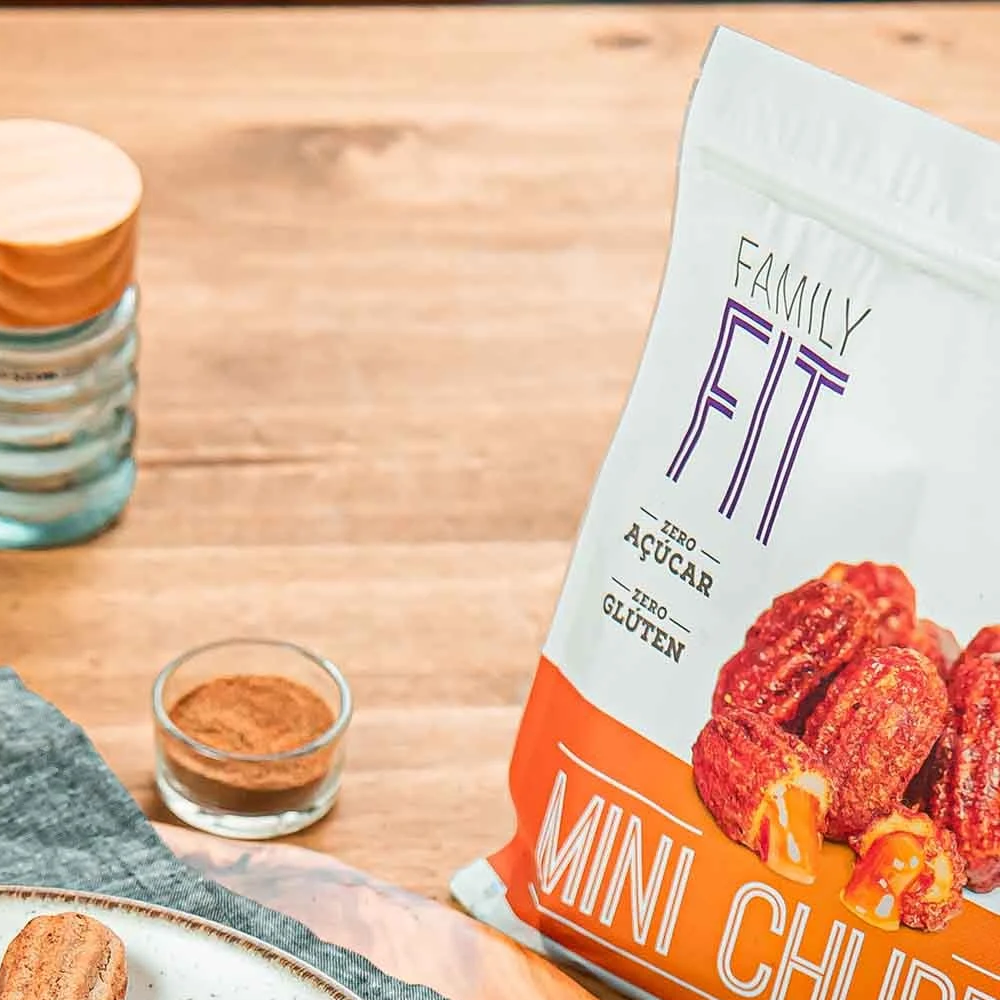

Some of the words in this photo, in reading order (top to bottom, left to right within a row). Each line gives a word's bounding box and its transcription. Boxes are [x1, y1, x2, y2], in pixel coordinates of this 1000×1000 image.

[734, 235, 871, 356] FAMILY
[665, 298, 849, 546] FIT
[624, 523, 713, 597] AÇÚCAR
[660, 520, 696, 551] ZERO
[602, 593, 685, 663] GLÚTEN
[631, 588, 667, 620] ZERO
[535, 769, 695, 957] MINI
